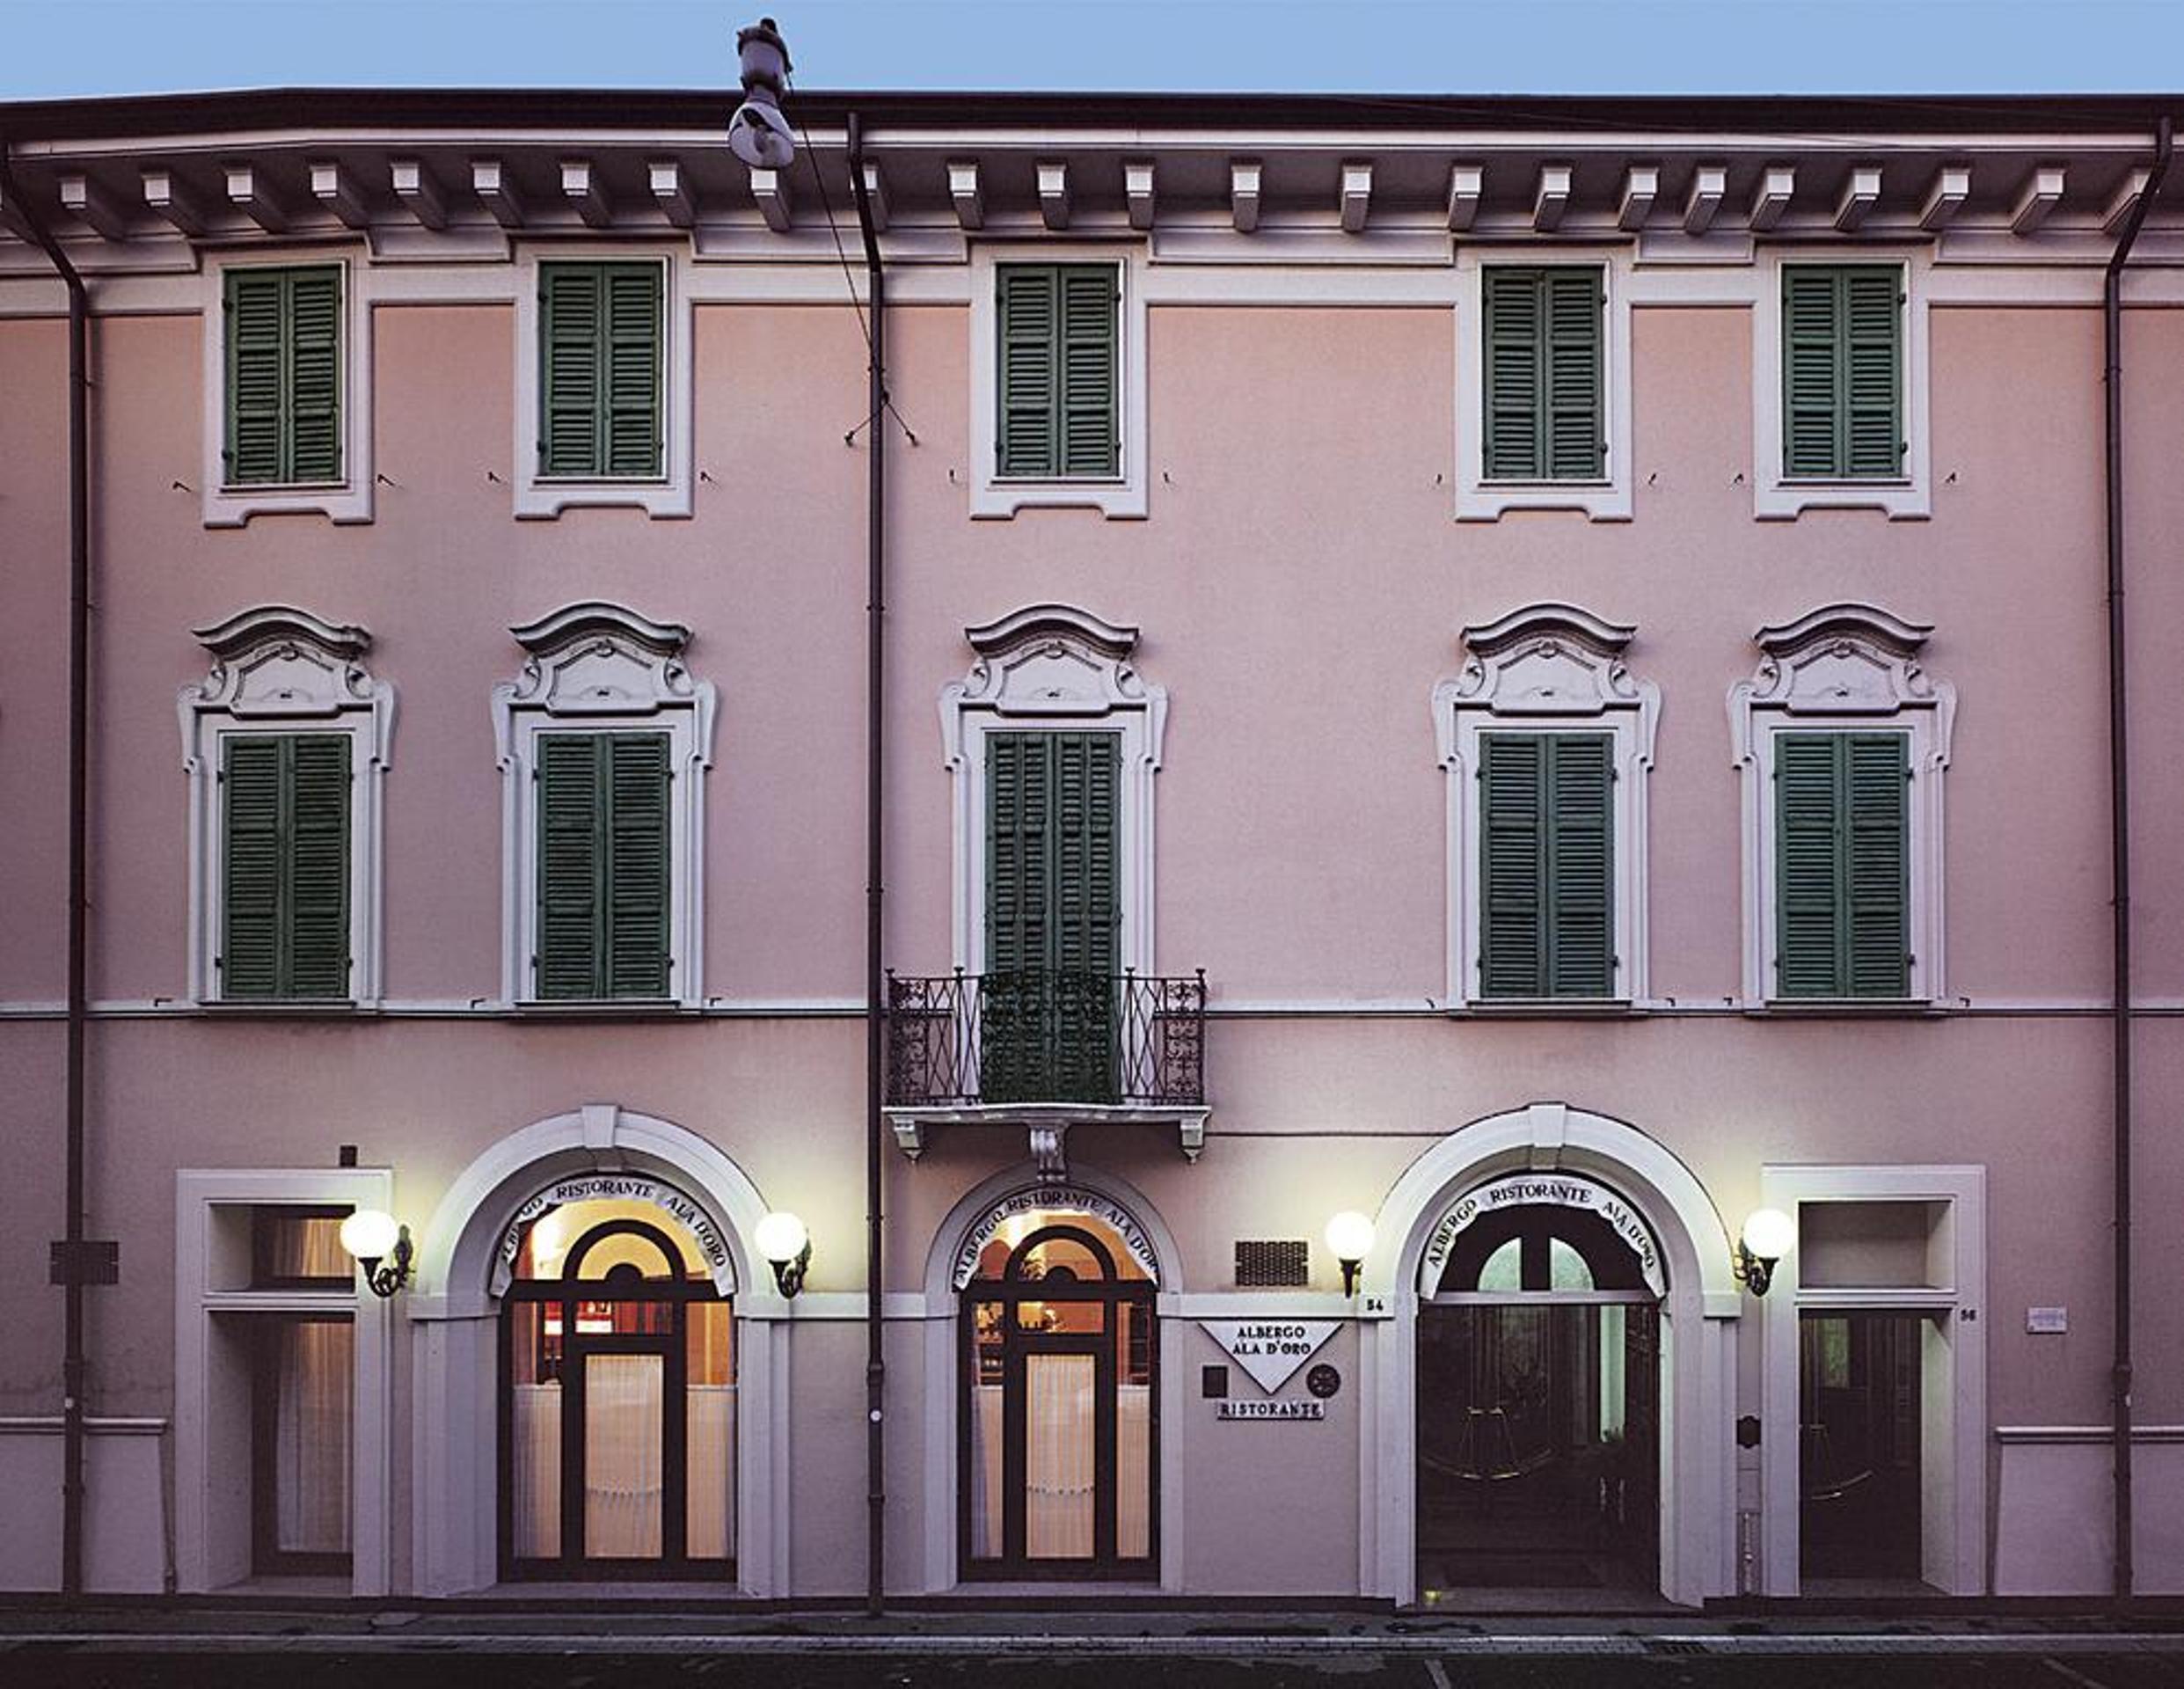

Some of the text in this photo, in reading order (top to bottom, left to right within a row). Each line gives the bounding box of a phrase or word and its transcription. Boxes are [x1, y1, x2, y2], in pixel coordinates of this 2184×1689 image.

[556, 1180, 654, 1199] RISTORANTE
[666, 1196, 696, 1225] ALA
[955, 1210, 1008, 1281] ALBERGO
[1006, 1190, 1102, 1212] RISTORANTE
[1106, 1210, 1133, 1238] ALA
[1428, 1199, 1477, 1268] ALBERGO
[1489, 1184, 1593, 1203] RISTORANTE
[1603, 1202, 1627, 1227] ALA
[1238, 1326, 1306, 1338] ALBERGO
[1233, 1340, 1311, 1355] ALA D'ORO
[1220, 1403, 1320, 1416] RISTORANTE
